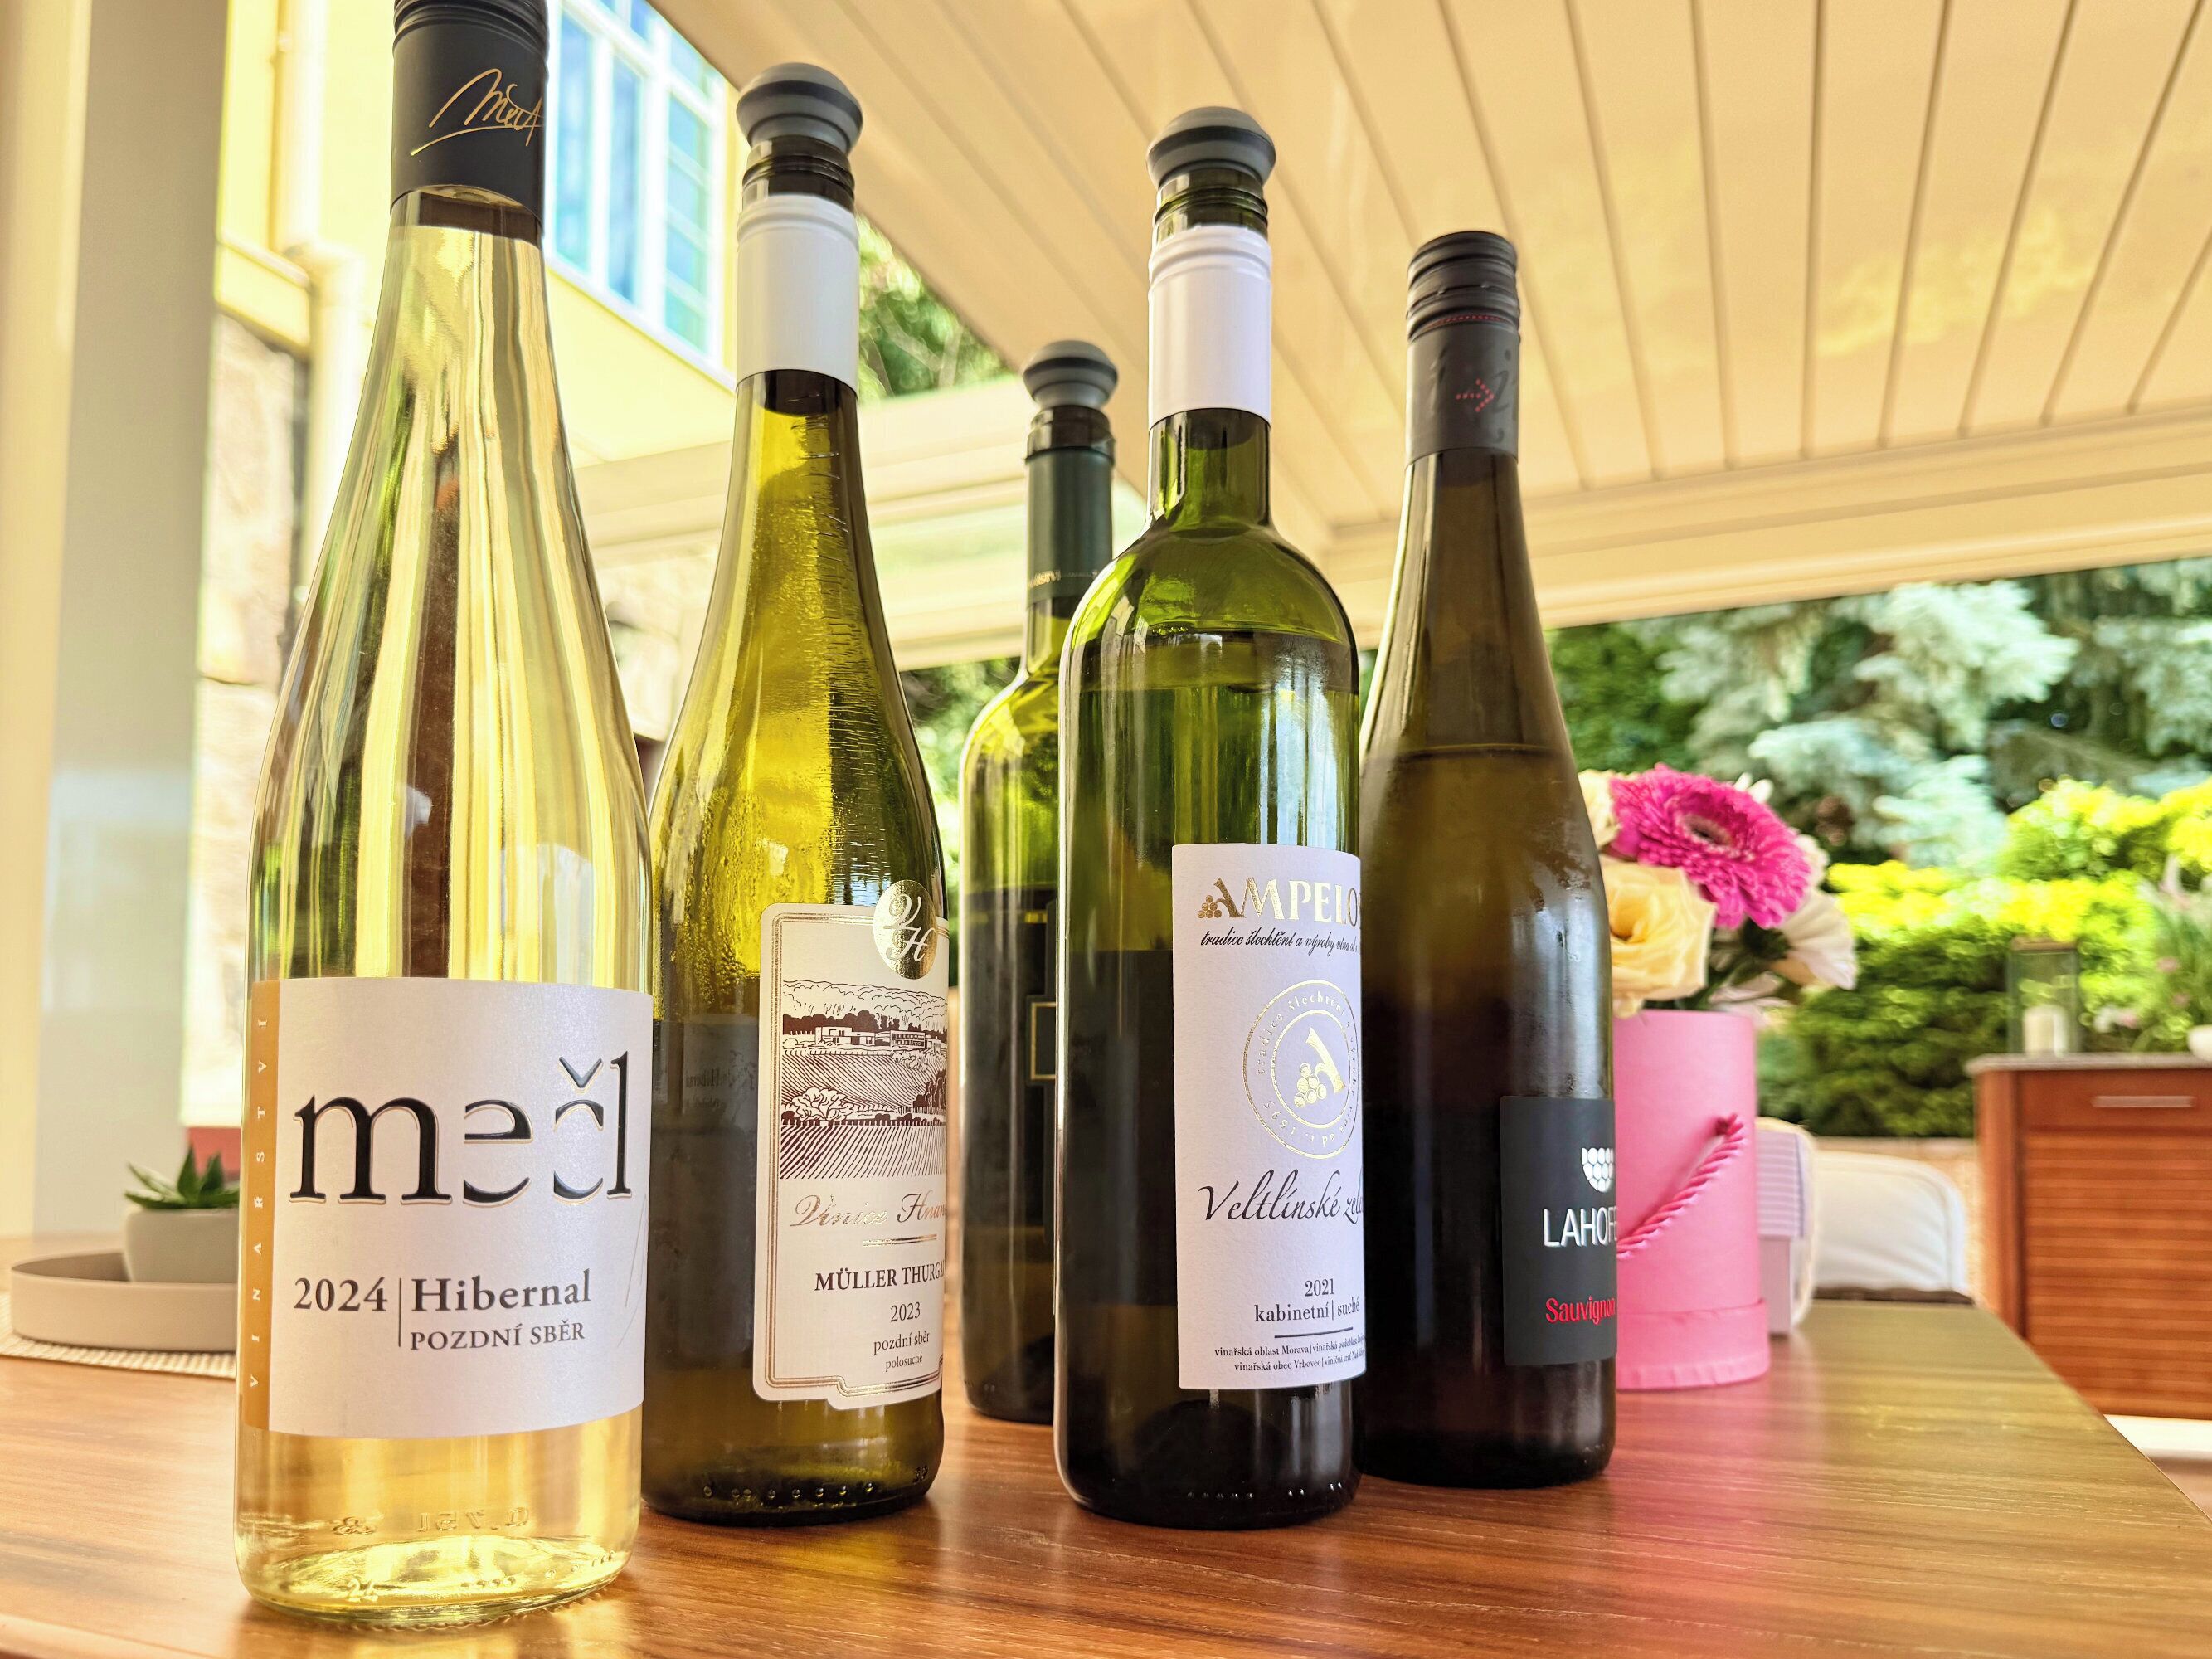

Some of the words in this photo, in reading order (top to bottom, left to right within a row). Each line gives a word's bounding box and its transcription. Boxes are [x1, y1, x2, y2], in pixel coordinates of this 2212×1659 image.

[1201, 927, 1244, 946] tradice
[1295, 937, 1302, 946] a
[1198, 1169, 1341, 1220] Veltlínské
[293, 1277, 388, 1312] 2024
[411, 1268, 591, 1312] Hibernal
[814, 1267, 897, 1291] MÜLLER
[1305, 1278, 1334, 1297] 2021
[890, 1301, 921, 1322] 2023
[1254, 1301, 1329, 1321] kabinetní
[1337, 1296, 1359, 1316] suché
[410, 1323, 522, 1350] POZDNÍ
[530, 1320, 586, 1345] SBĚR
[873, 1332, 912, 1356] pozdní
[914, 1330, 930, 1345] sběr
[886, 1351, 923, 1372] polosuché
[1214, 1347, 1252, 1356] vinařská
[1255, 1345, 1279, 1355] oblast
[1281, 1345, 1309, 1355] Morava
[1234, 1361, 1271, 1371] vinařská
[1273, 1361, 1291, 1370] obec
[1293, 1358, 1321, 1369] Vrbovec
